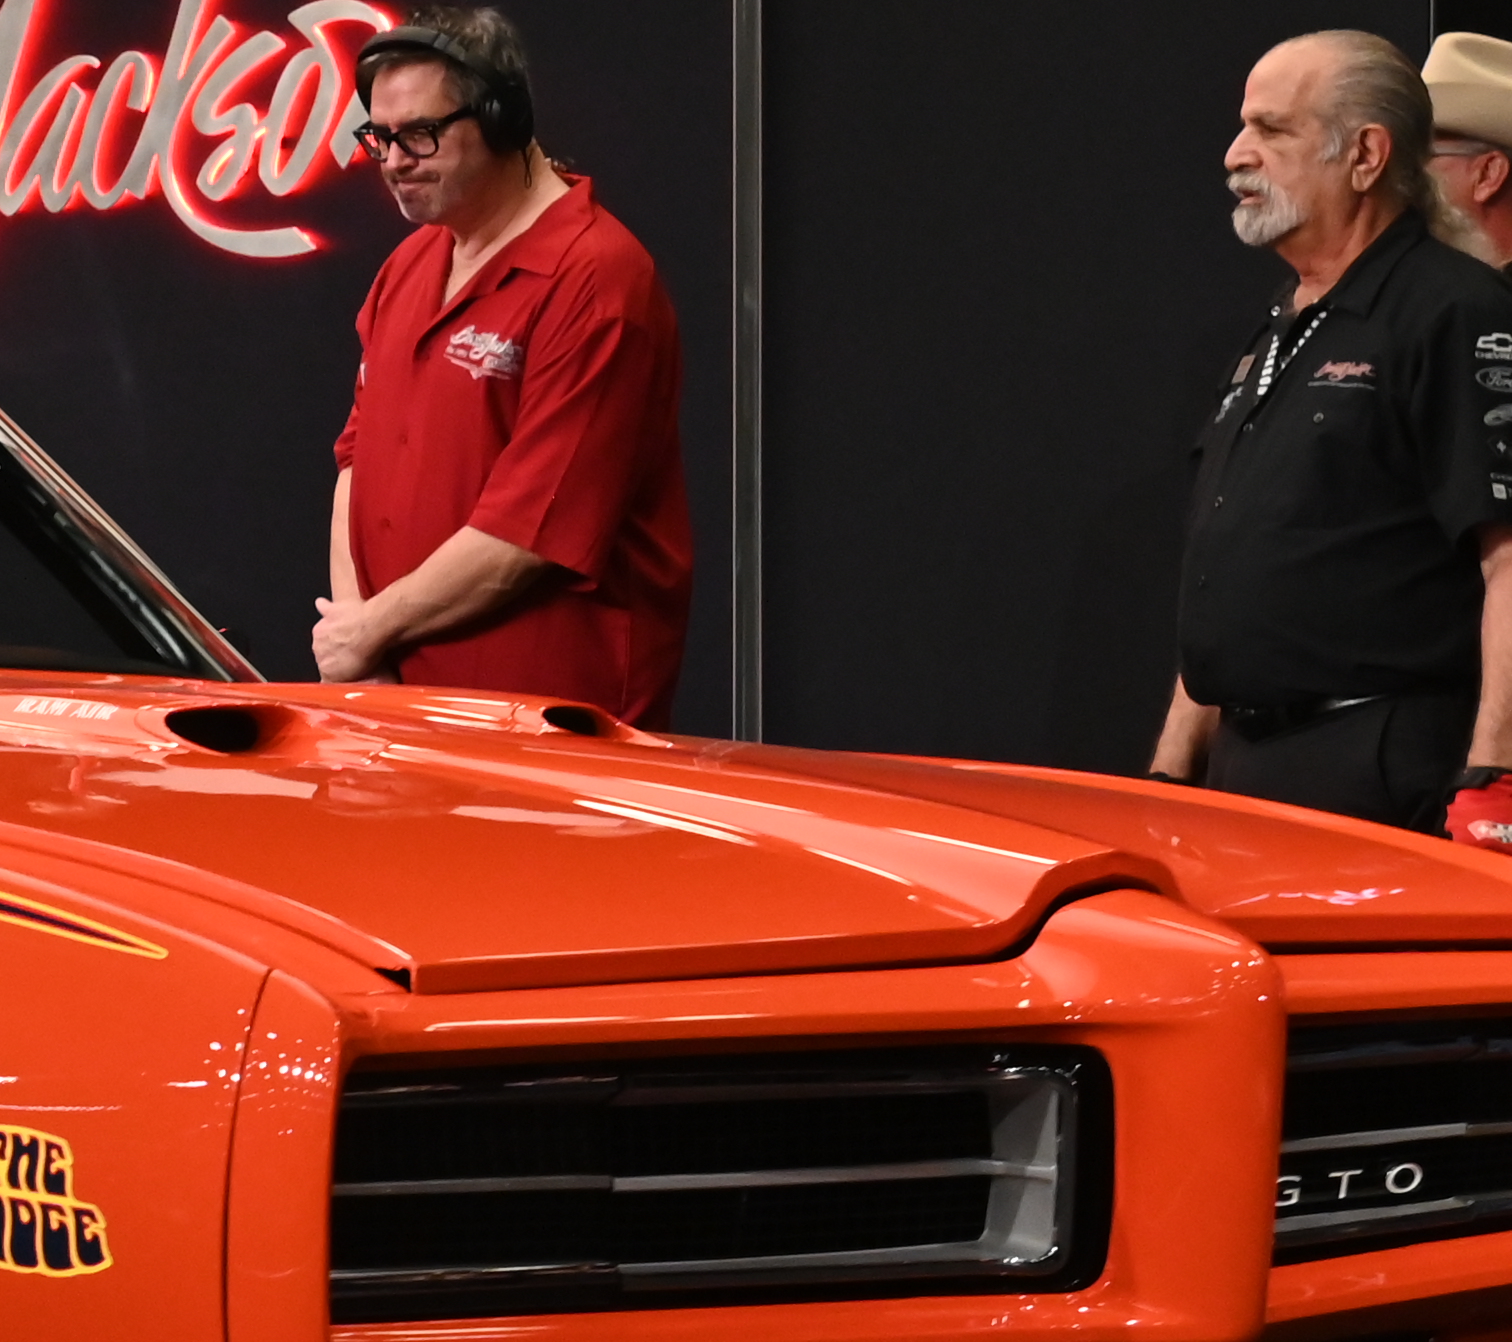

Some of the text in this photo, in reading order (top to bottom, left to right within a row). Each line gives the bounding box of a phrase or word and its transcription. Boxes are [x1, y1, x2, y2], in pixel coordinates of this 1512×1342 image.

[13, 696, 120, 721] RAM AIR
[1275, 1161, 1424, 1208] GTO
